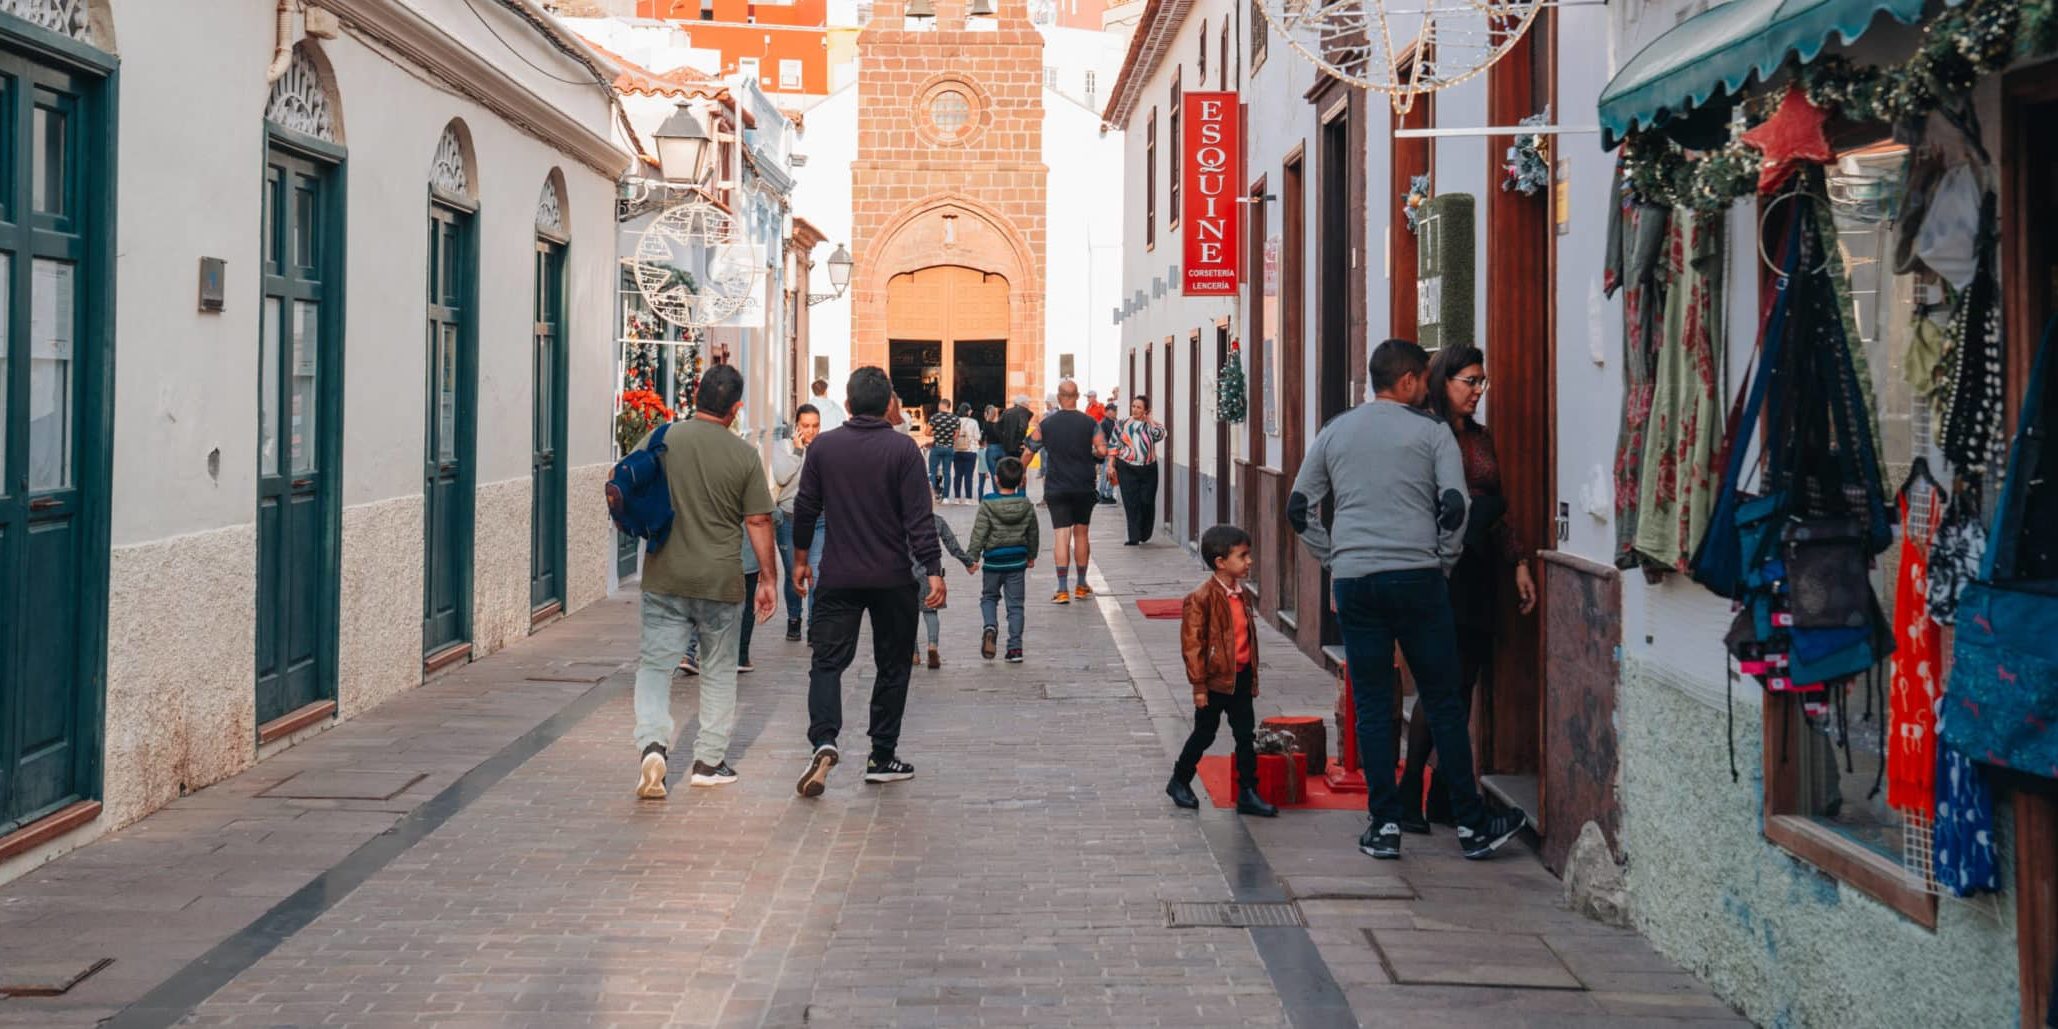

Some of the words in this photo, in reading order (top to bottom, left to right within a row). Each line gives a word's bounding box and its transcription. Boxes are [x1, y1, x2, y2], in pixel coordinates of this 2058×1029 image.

[1197, 100, 1226, 263] ESQUINE
[1188, 268, 1235, 277] CORSETERÍA
[1192, 280, 1230, 289] LENCERÍA
